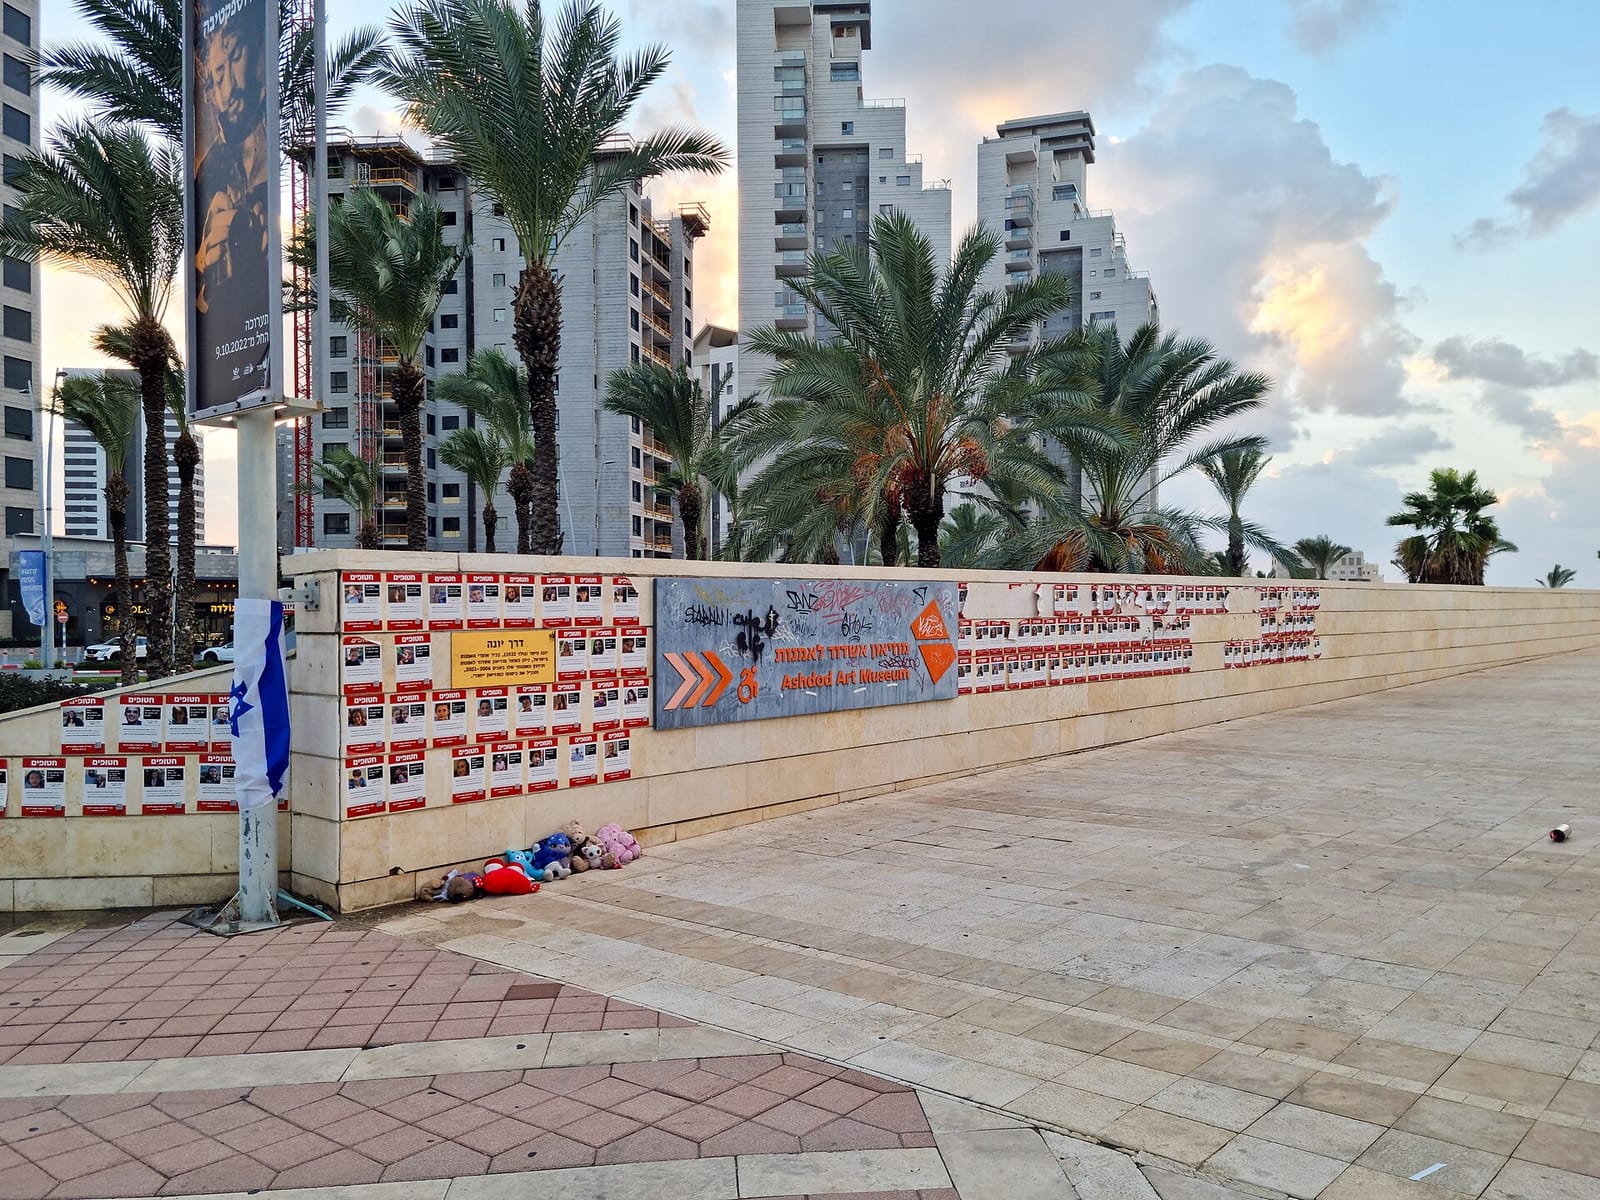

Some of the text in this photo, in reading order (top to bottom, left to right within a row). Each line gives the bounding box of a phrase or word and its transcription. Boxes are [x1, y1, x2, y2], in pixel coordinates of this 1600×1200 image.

[245, 314, 269, 331] תערוכה
[256, 331, 269, 345] החל
[487, 639, 524, 649] דרך יונה
[775, 642, 910, 663] מוזיאון אשדוד לאמנות
[782, 668, 910, 689] Ashdod Art Museum
[127, 696, 155, 704] חטופים
[30, 759, 58, 767] חטופים
